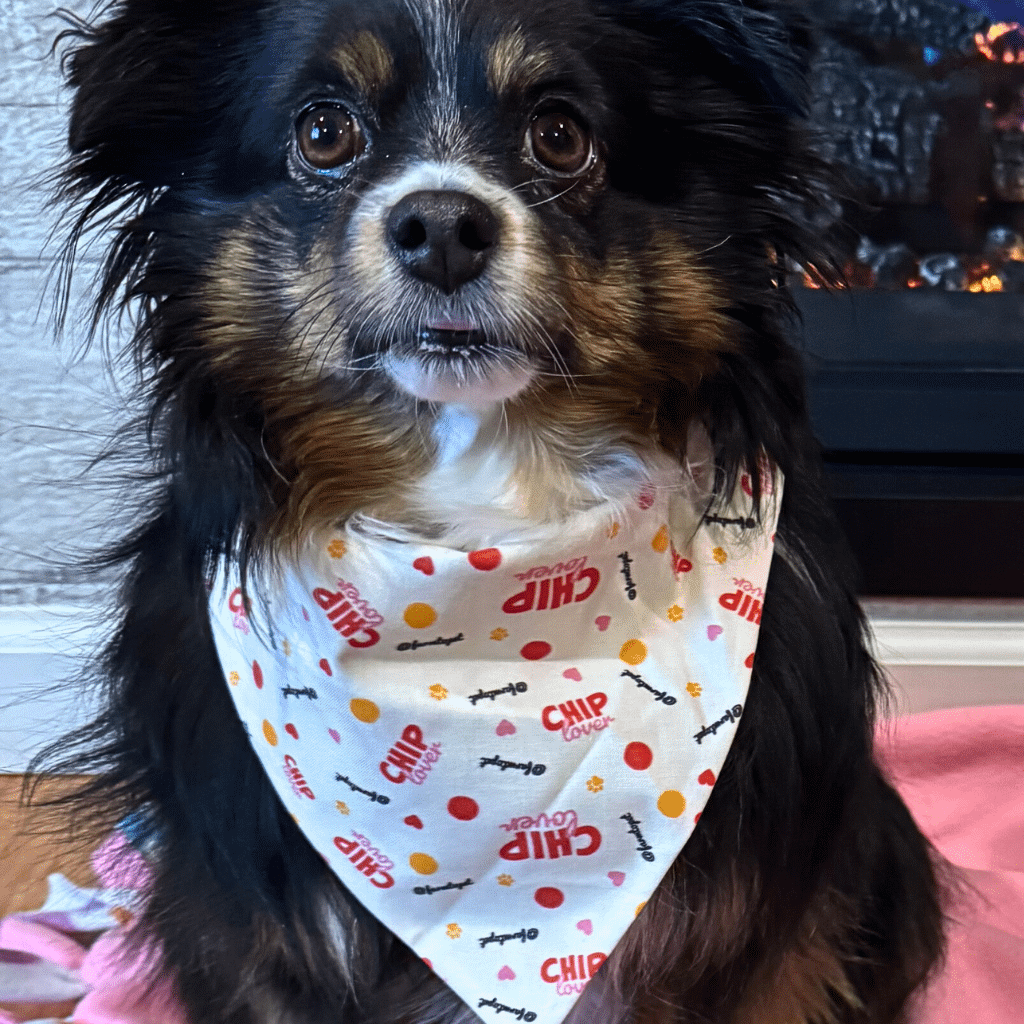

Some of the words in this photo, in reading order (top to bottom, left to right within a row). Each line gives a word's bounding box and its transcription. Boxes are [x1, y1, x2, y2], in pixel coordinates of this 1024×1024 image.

[501, 567, 600, 614] CHIP
[718, 589, 762, 625] HIP
[312, 587, 381, 648] CHIP
[541, 692, 608, 731] CHIP
[561, 714, 616, 742] lover
[379, 724, 428, 784] CHIP
[498, 809, 578, 838] lover
[498, 825, 602, 861] CHIP
[333, 836, 395, 889] CHIP
[540, 952, 609, 983] CHIP
